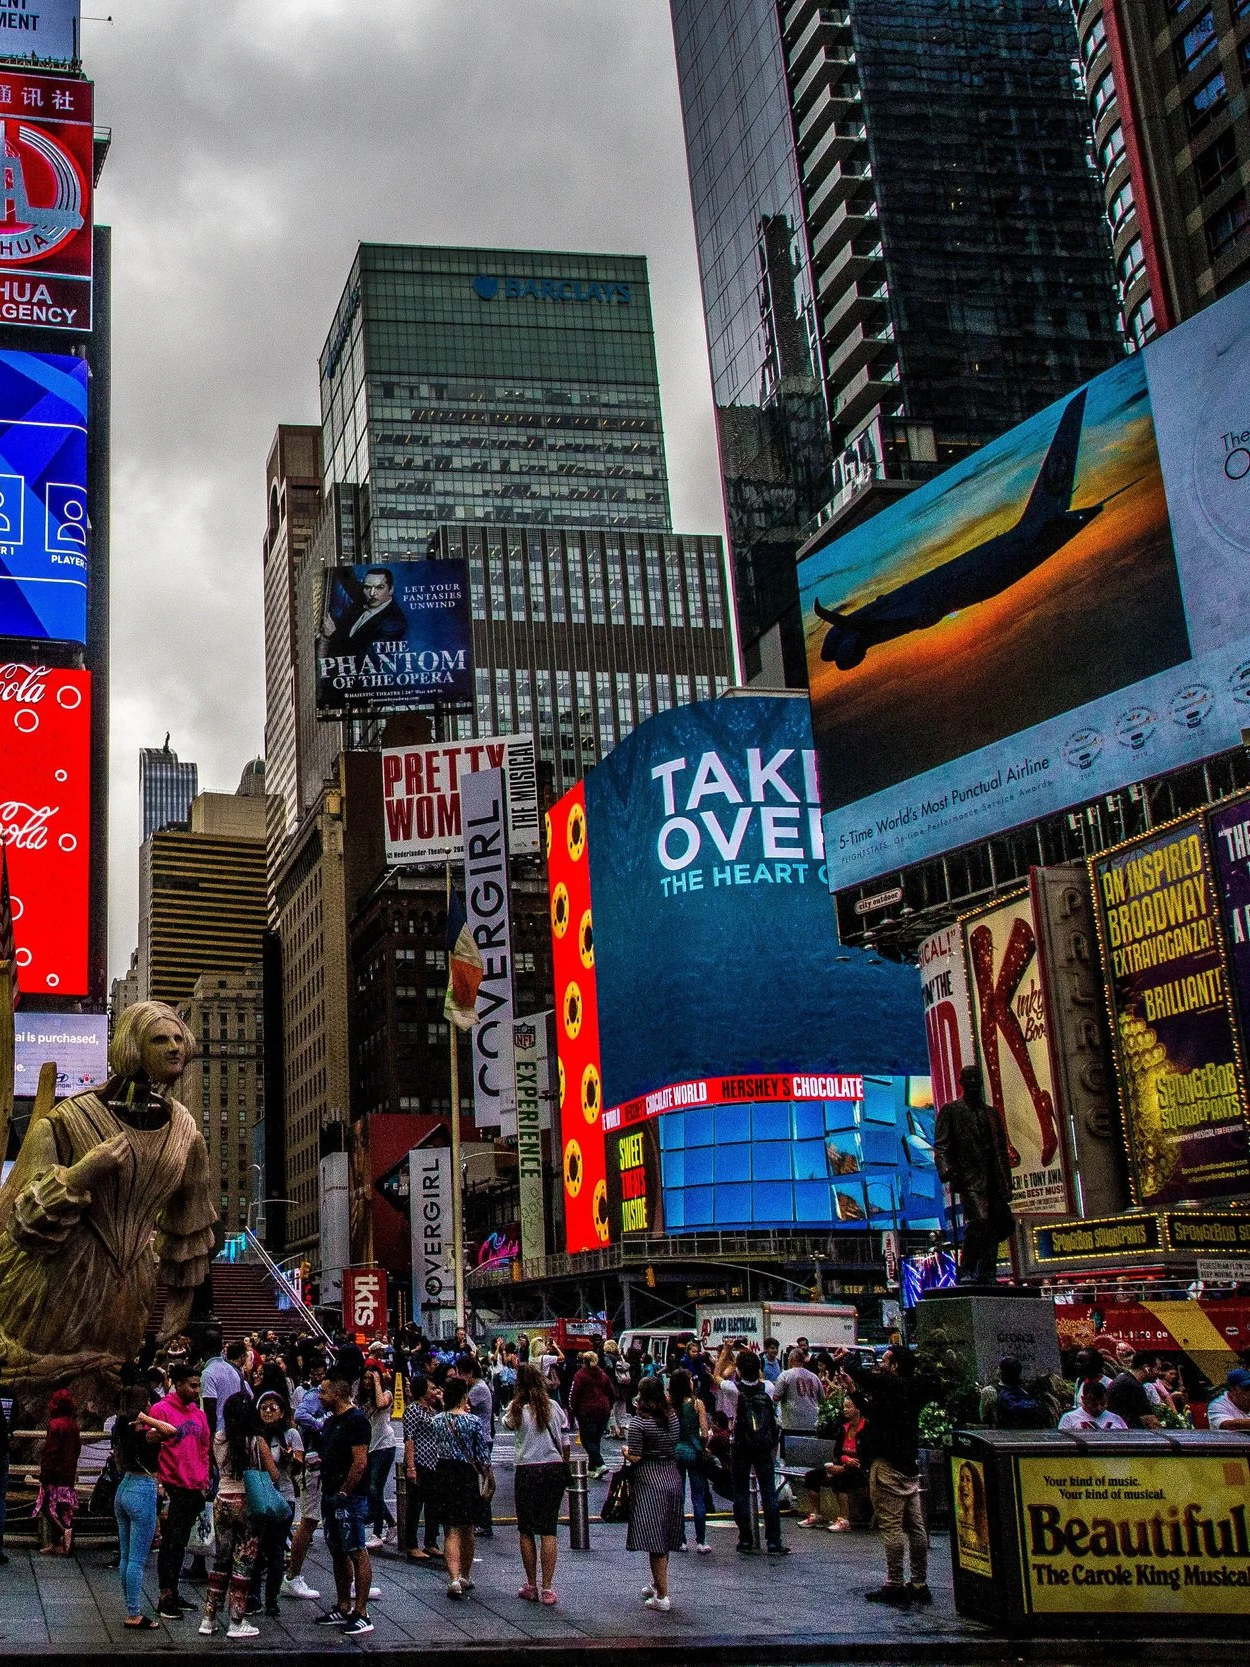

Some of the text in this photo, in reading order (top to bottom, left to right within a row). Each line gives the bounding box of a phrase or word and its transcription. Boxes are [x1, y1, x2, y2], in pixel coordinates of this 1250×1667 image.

[505, 278, 632, 304] BARCLAYS
[10, 546, 15, 555] 1
[51, 555, 85, 568] PLAYER
[403, 592, 462, 602] FANTASIES
[404, 583, 460, 593] LET YOUR
[410, 601, 455, 610] UNWIND
[373, 641, 409, 653] THE
[319, 650, 467, 678] PHANTOM
[332, 671, 454, 689] OF THE OPERA
[383, 743, 506, 798] PRETTY
[508, 740, 538, 831] THE MUSICAL
[839, 757, 1049, 850] 5-Time World's Most Punctual Airline
[385, 793, 463, 842] WOM
[394, 850, 426, 858] Nederlander
[660, 870, 704, 897] THE
[713, 863, 808, 886] HEART
[1103, 833, 1202, 907] AN INSPIRED
[858, 892, 899, 911] city outdoor
[1108, 874, 1209, 947] BROADWAY
[468, 799, 510, 1097] COVERGIRL
[1112, 916, 1215, 978] EXTRAVAGANZA!
[27, 1032, 36, 1042] is
[38, 1033, 99, 1048] purchased,
[515, 1033, 534, 1045] NFL
[645, 1087, 673, 1115] CHOCOLATE
[673, 1082, 707, 1105] WORLD
[721, 1077, 791, 1099] HERSHEY'S
[793, 1077, 863, 1098] CHOCOLATE
[515, 1061, 542, 1179] EXPERIENCE
[619, 1132, 644, 1171] SWEET
[1026, 1188, 1044, 1198] BEST
[1029, 1171, 1046, 1189] TONY
[621, 1197, 648, 1233] INSIDE
[354, 1274, 380, 1327] tkts
[728, 1317, 757, 1333] ELECTRICAL
[1044, 1475, 1141, 1487] Your kind of music.
[1059, 1488, 1167, 1500] Your kind of musical.
[1027, 1503, 1250, 1558] Beautiful
[1032, 1563, 1069, 1586] The
[1072, 1563, 1132, 1586] Carole
[1136, 1564, 1180, 1591] King
